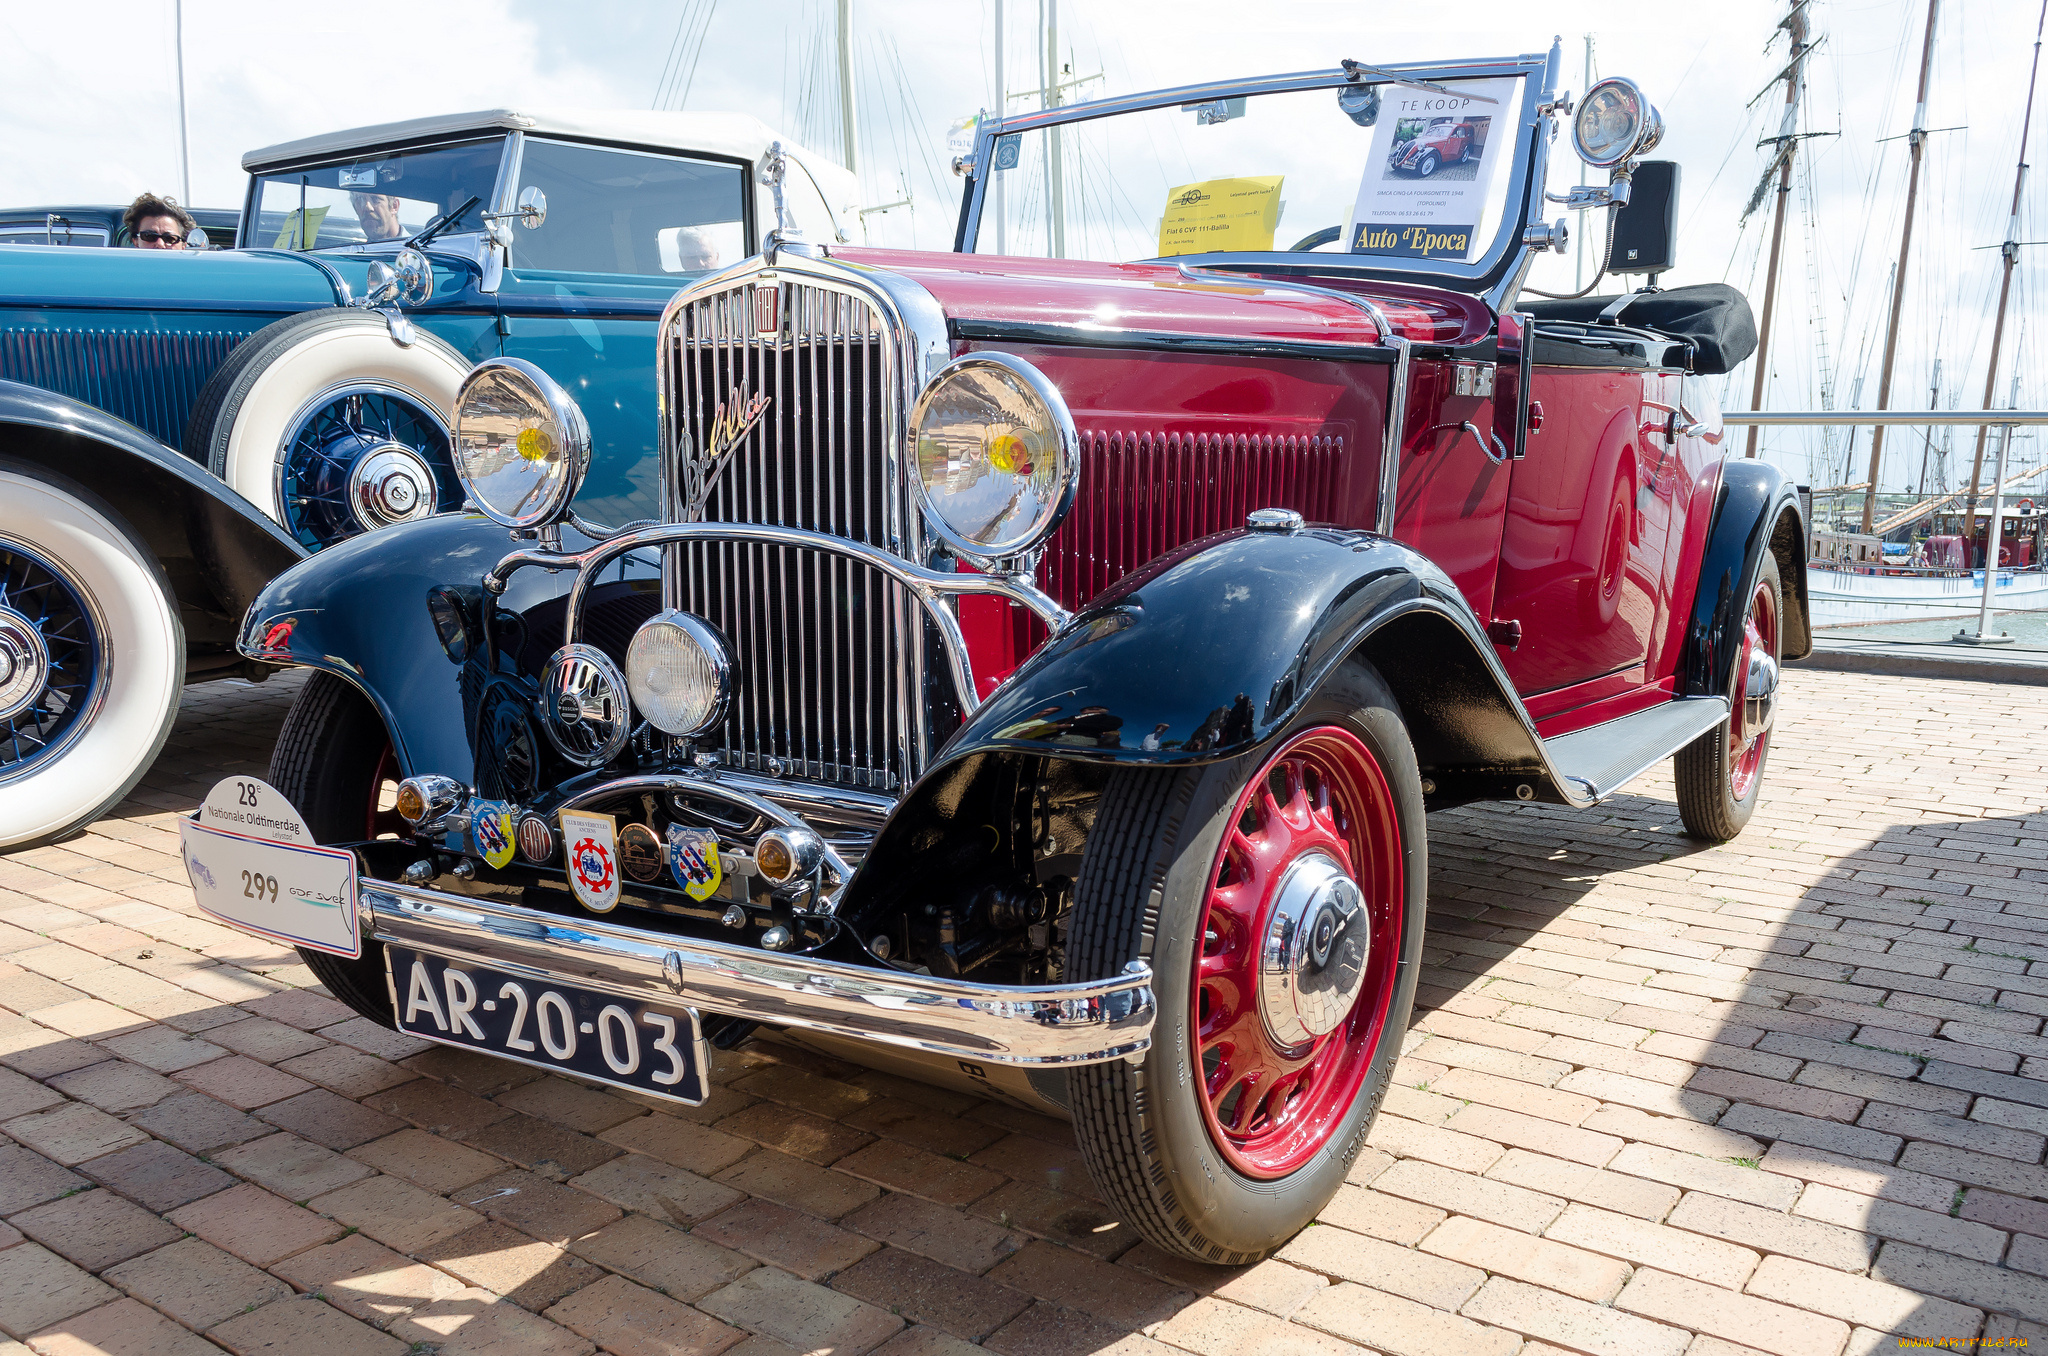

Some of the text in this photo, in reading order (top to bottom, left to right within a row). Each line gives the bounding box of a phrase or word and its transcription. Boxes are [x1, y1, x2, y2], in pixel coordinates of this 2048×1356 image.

[1401, 98, 1470, 111] TE KOOP
[1355, 226, 1467, 256] Auto d'Epoca
[757, 287, 776, 332] FIAT
[208, 805, 300, 836] Nationale Oldtimerdag
[523, 819, 547, 860] FIAT
[241, 869, 279, 904] 299
[406, 960, 685, 1085] AR-20-03
